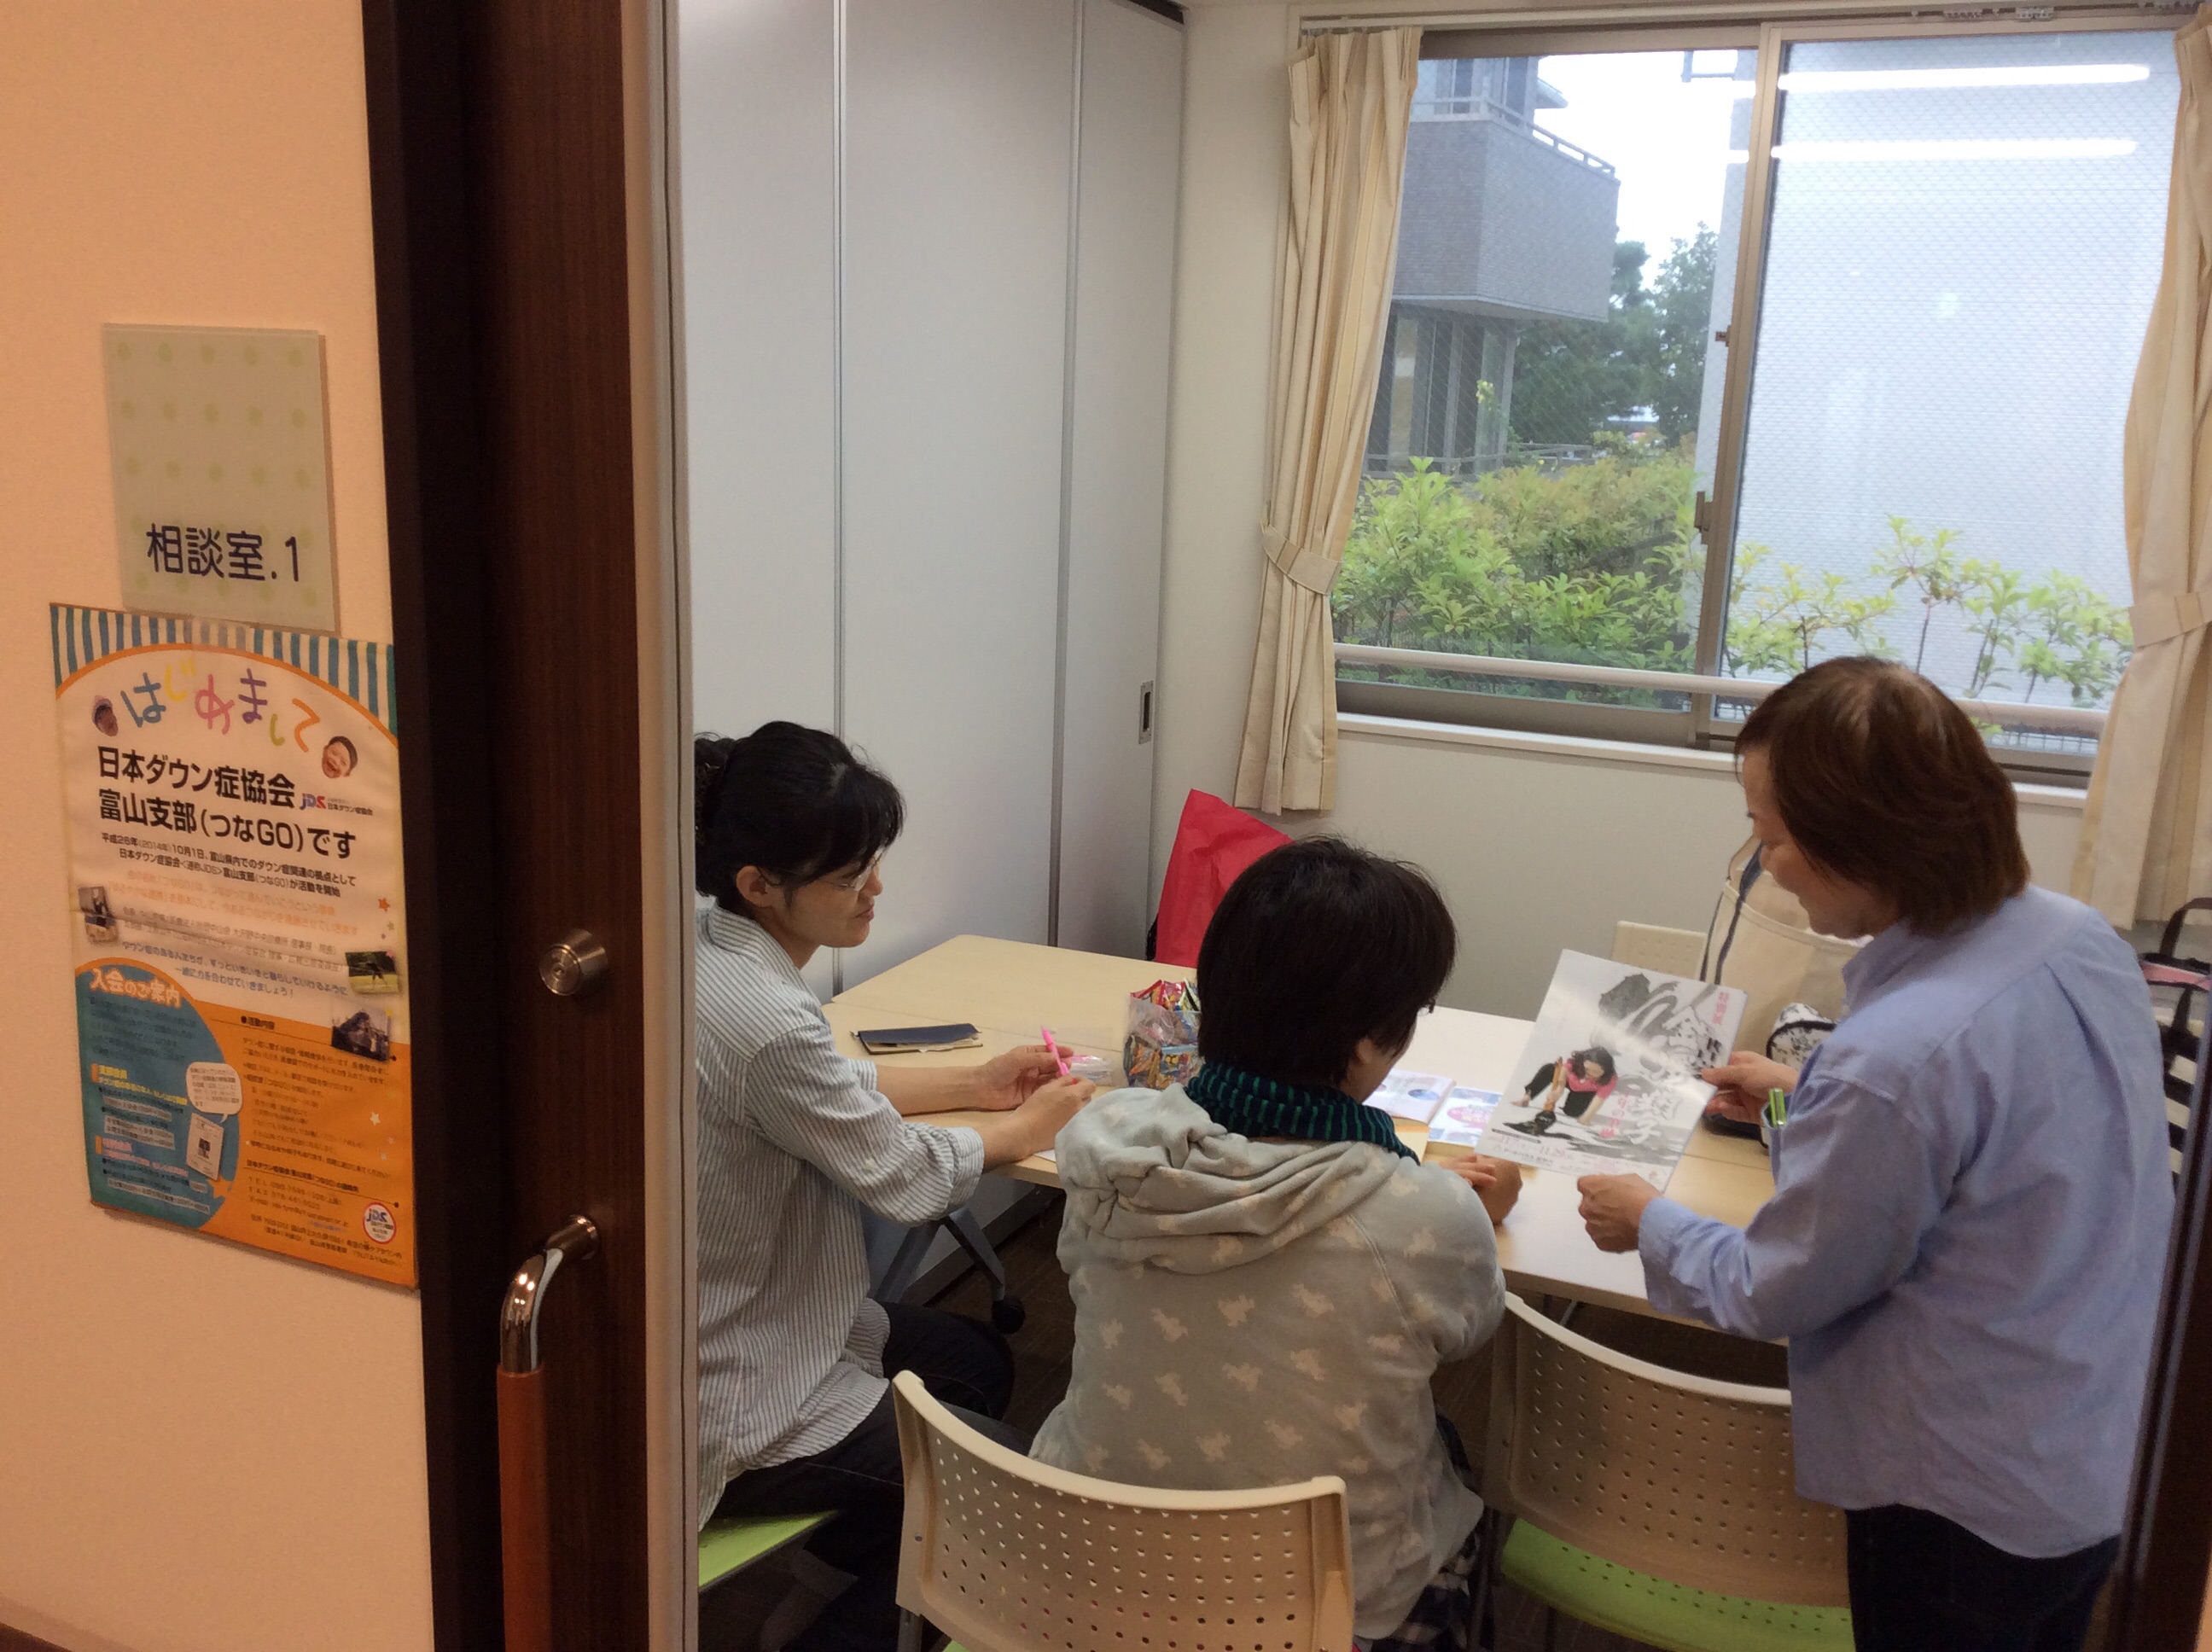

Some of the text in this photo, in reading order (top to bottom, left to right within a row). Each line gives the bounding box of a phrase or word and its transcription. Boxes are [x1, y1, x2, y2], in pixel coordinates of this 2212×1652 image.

[146, 523, 300, 582] 相談室.1
[120, 657, 321, 753] はじめまして
[97, 745, 296, 810] 日本ダウン症協会
